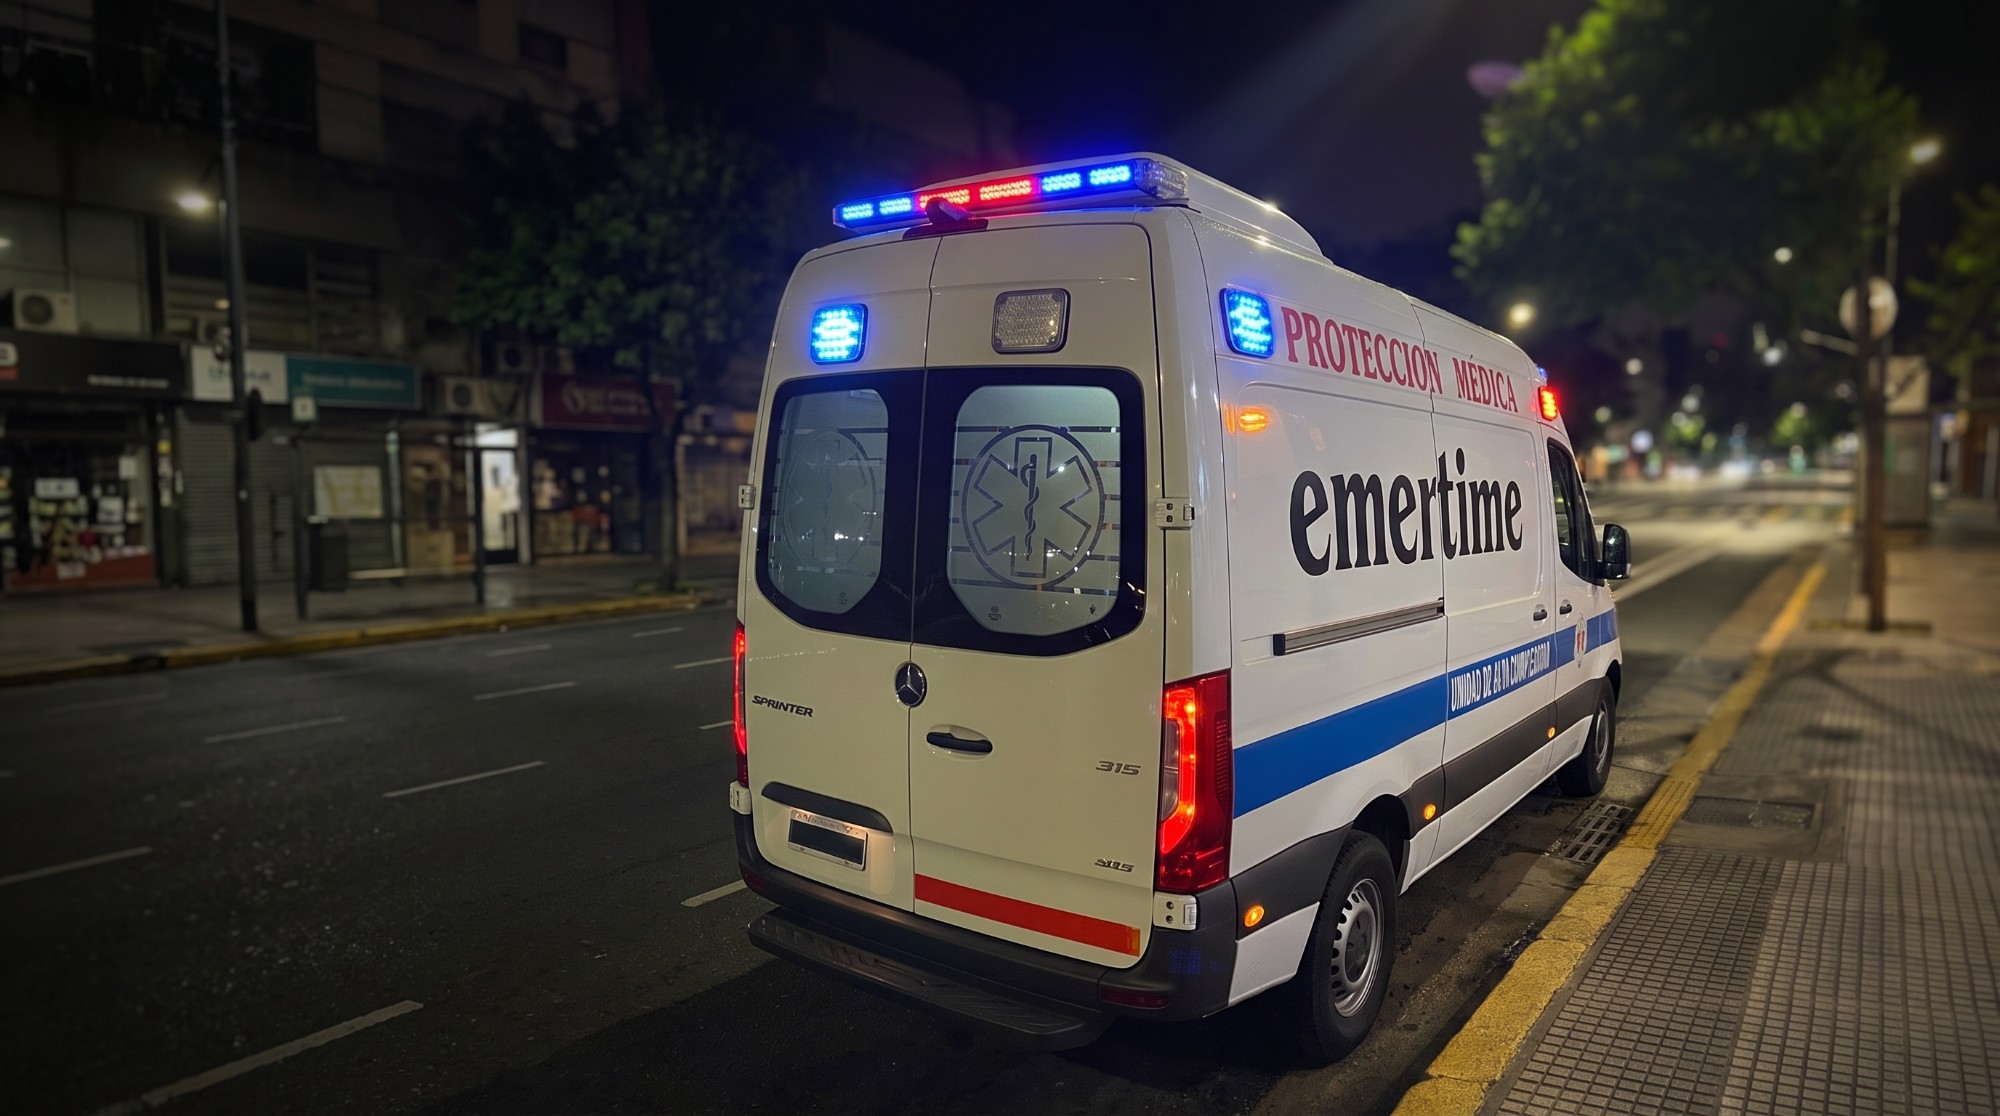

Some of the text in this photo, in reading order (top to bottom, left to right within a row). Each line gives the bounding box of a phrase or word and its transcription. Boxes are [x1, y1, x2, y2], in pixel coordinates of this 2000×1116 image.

[1281, 306, 1518, 412] PROTECCION MÉDICA
[1290, 447, 1523, 576] emertime
[752, 695, 813, 717] SPRINTER
[1096, 761, 1141, 775] 315
